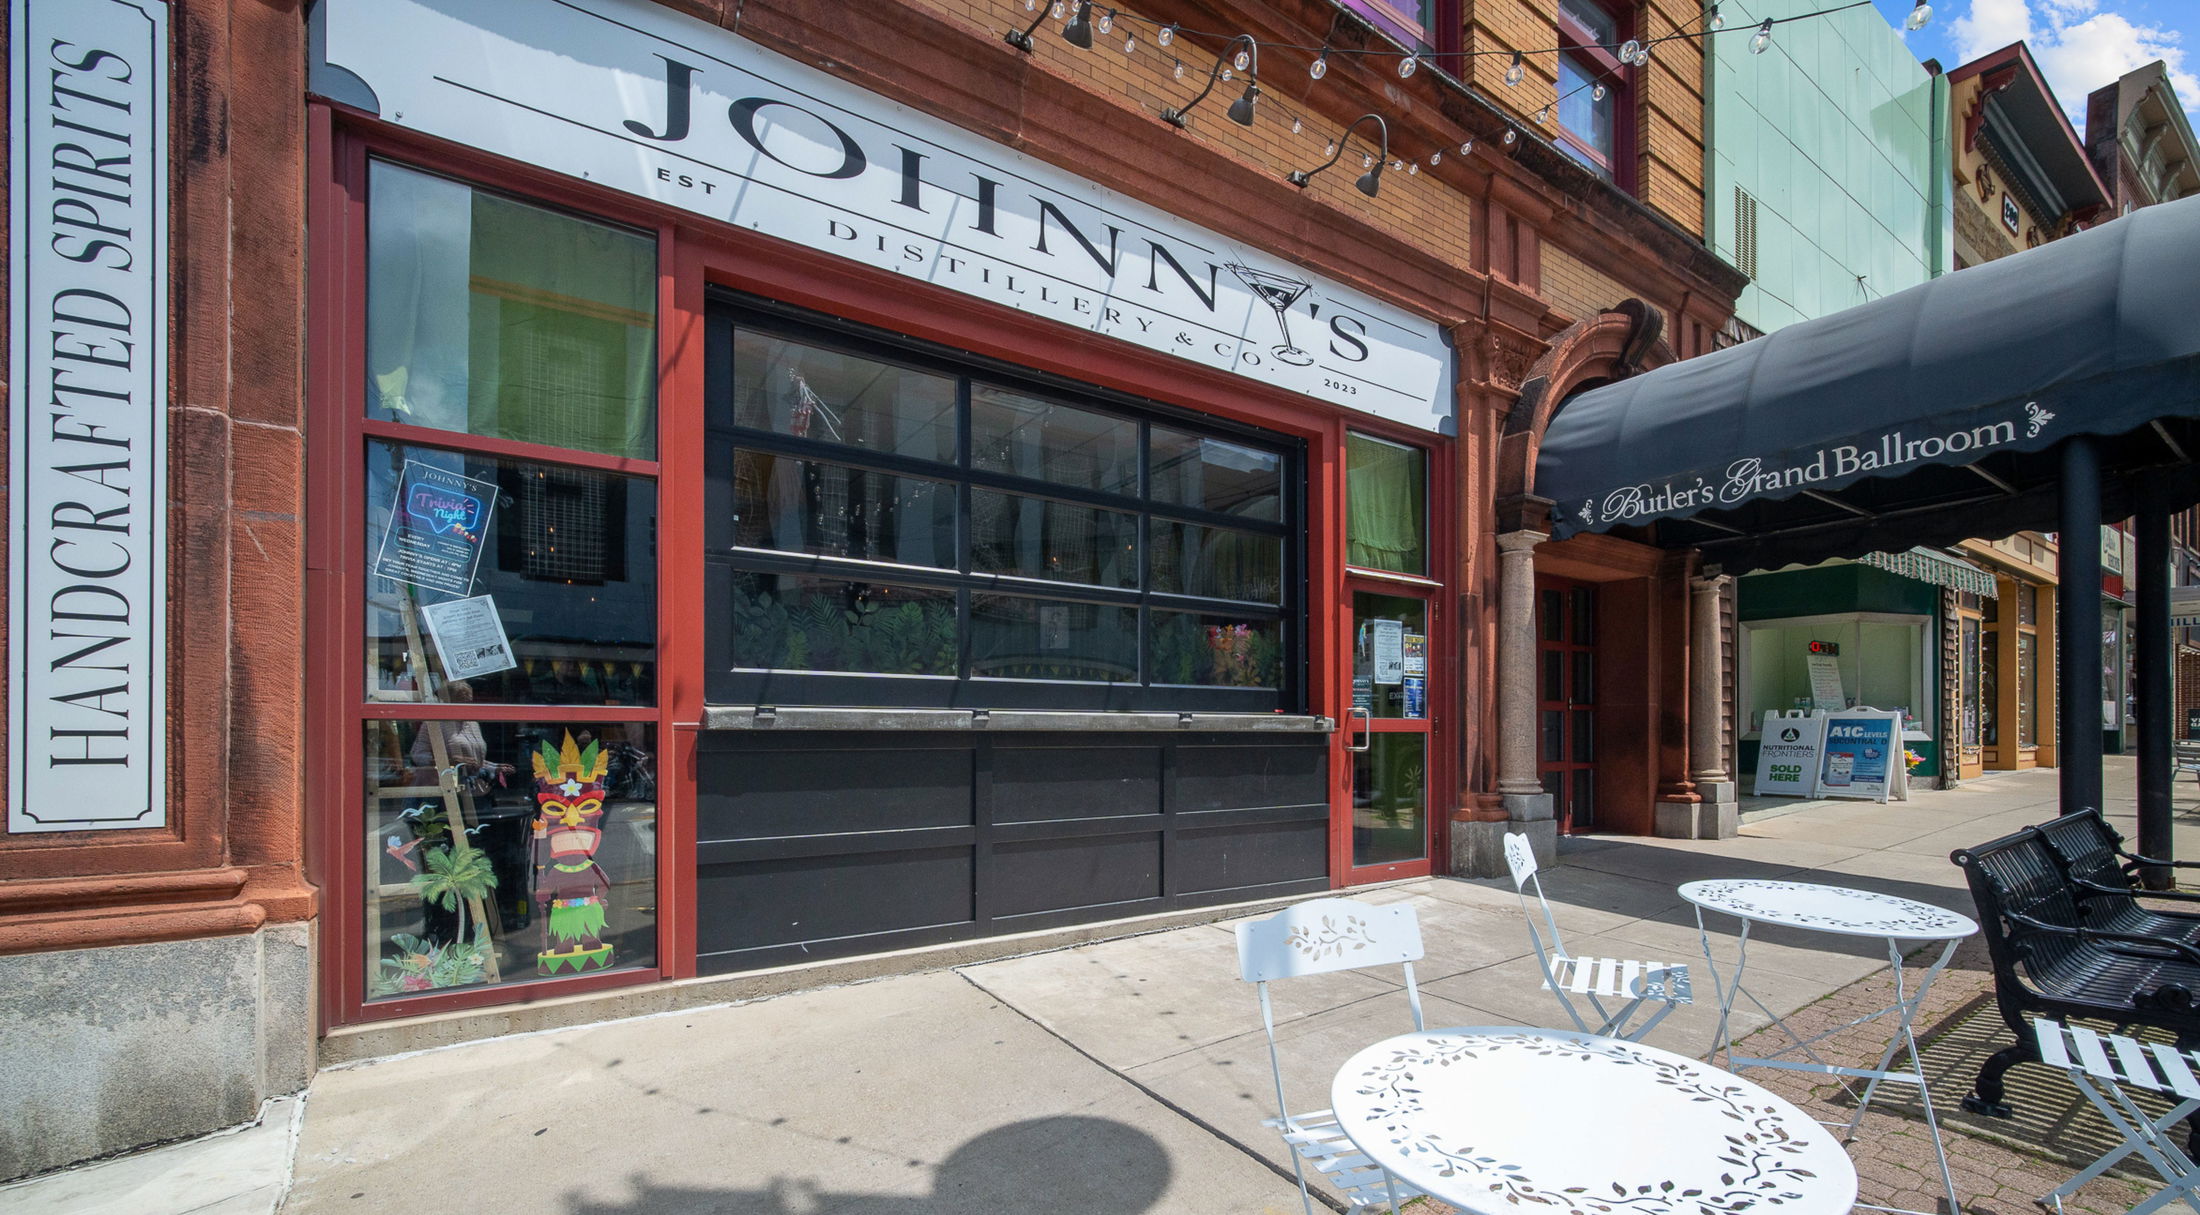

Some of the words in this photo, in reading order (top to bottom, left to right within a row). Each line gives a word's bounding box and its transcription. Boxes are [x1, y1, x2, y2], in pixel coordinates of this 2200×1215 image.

[50, 38, 133, 272] SPIRITS
[657, 167, 717, 195] EST
[828, 219, 1153, 332] DISTILLERY
[1175, 331, 1194, 346] &
[1214, 343, 1276, 372] CO.
[1324, 379, 1357, 395] 2023
[1601, 477, 1714, 522] Butler's
[1719, 449, 1829, 504] Grand
[1832, 420, 2016, 478] Ballroom
[424, 471, 478, 492] JOHNNY'S
[415, 492, 467, 511] Trivia
[434, 507, 467, 523] Night
[49, 289, 135, 768] HANDCRAFTED
[1829, 726, 1864, 737] A1C
[1763, 750, 1815, 758] FRONTIERS
[1769, 773, 1800, 782] HERE
[1770, 764, 1802, 773] SOLD
